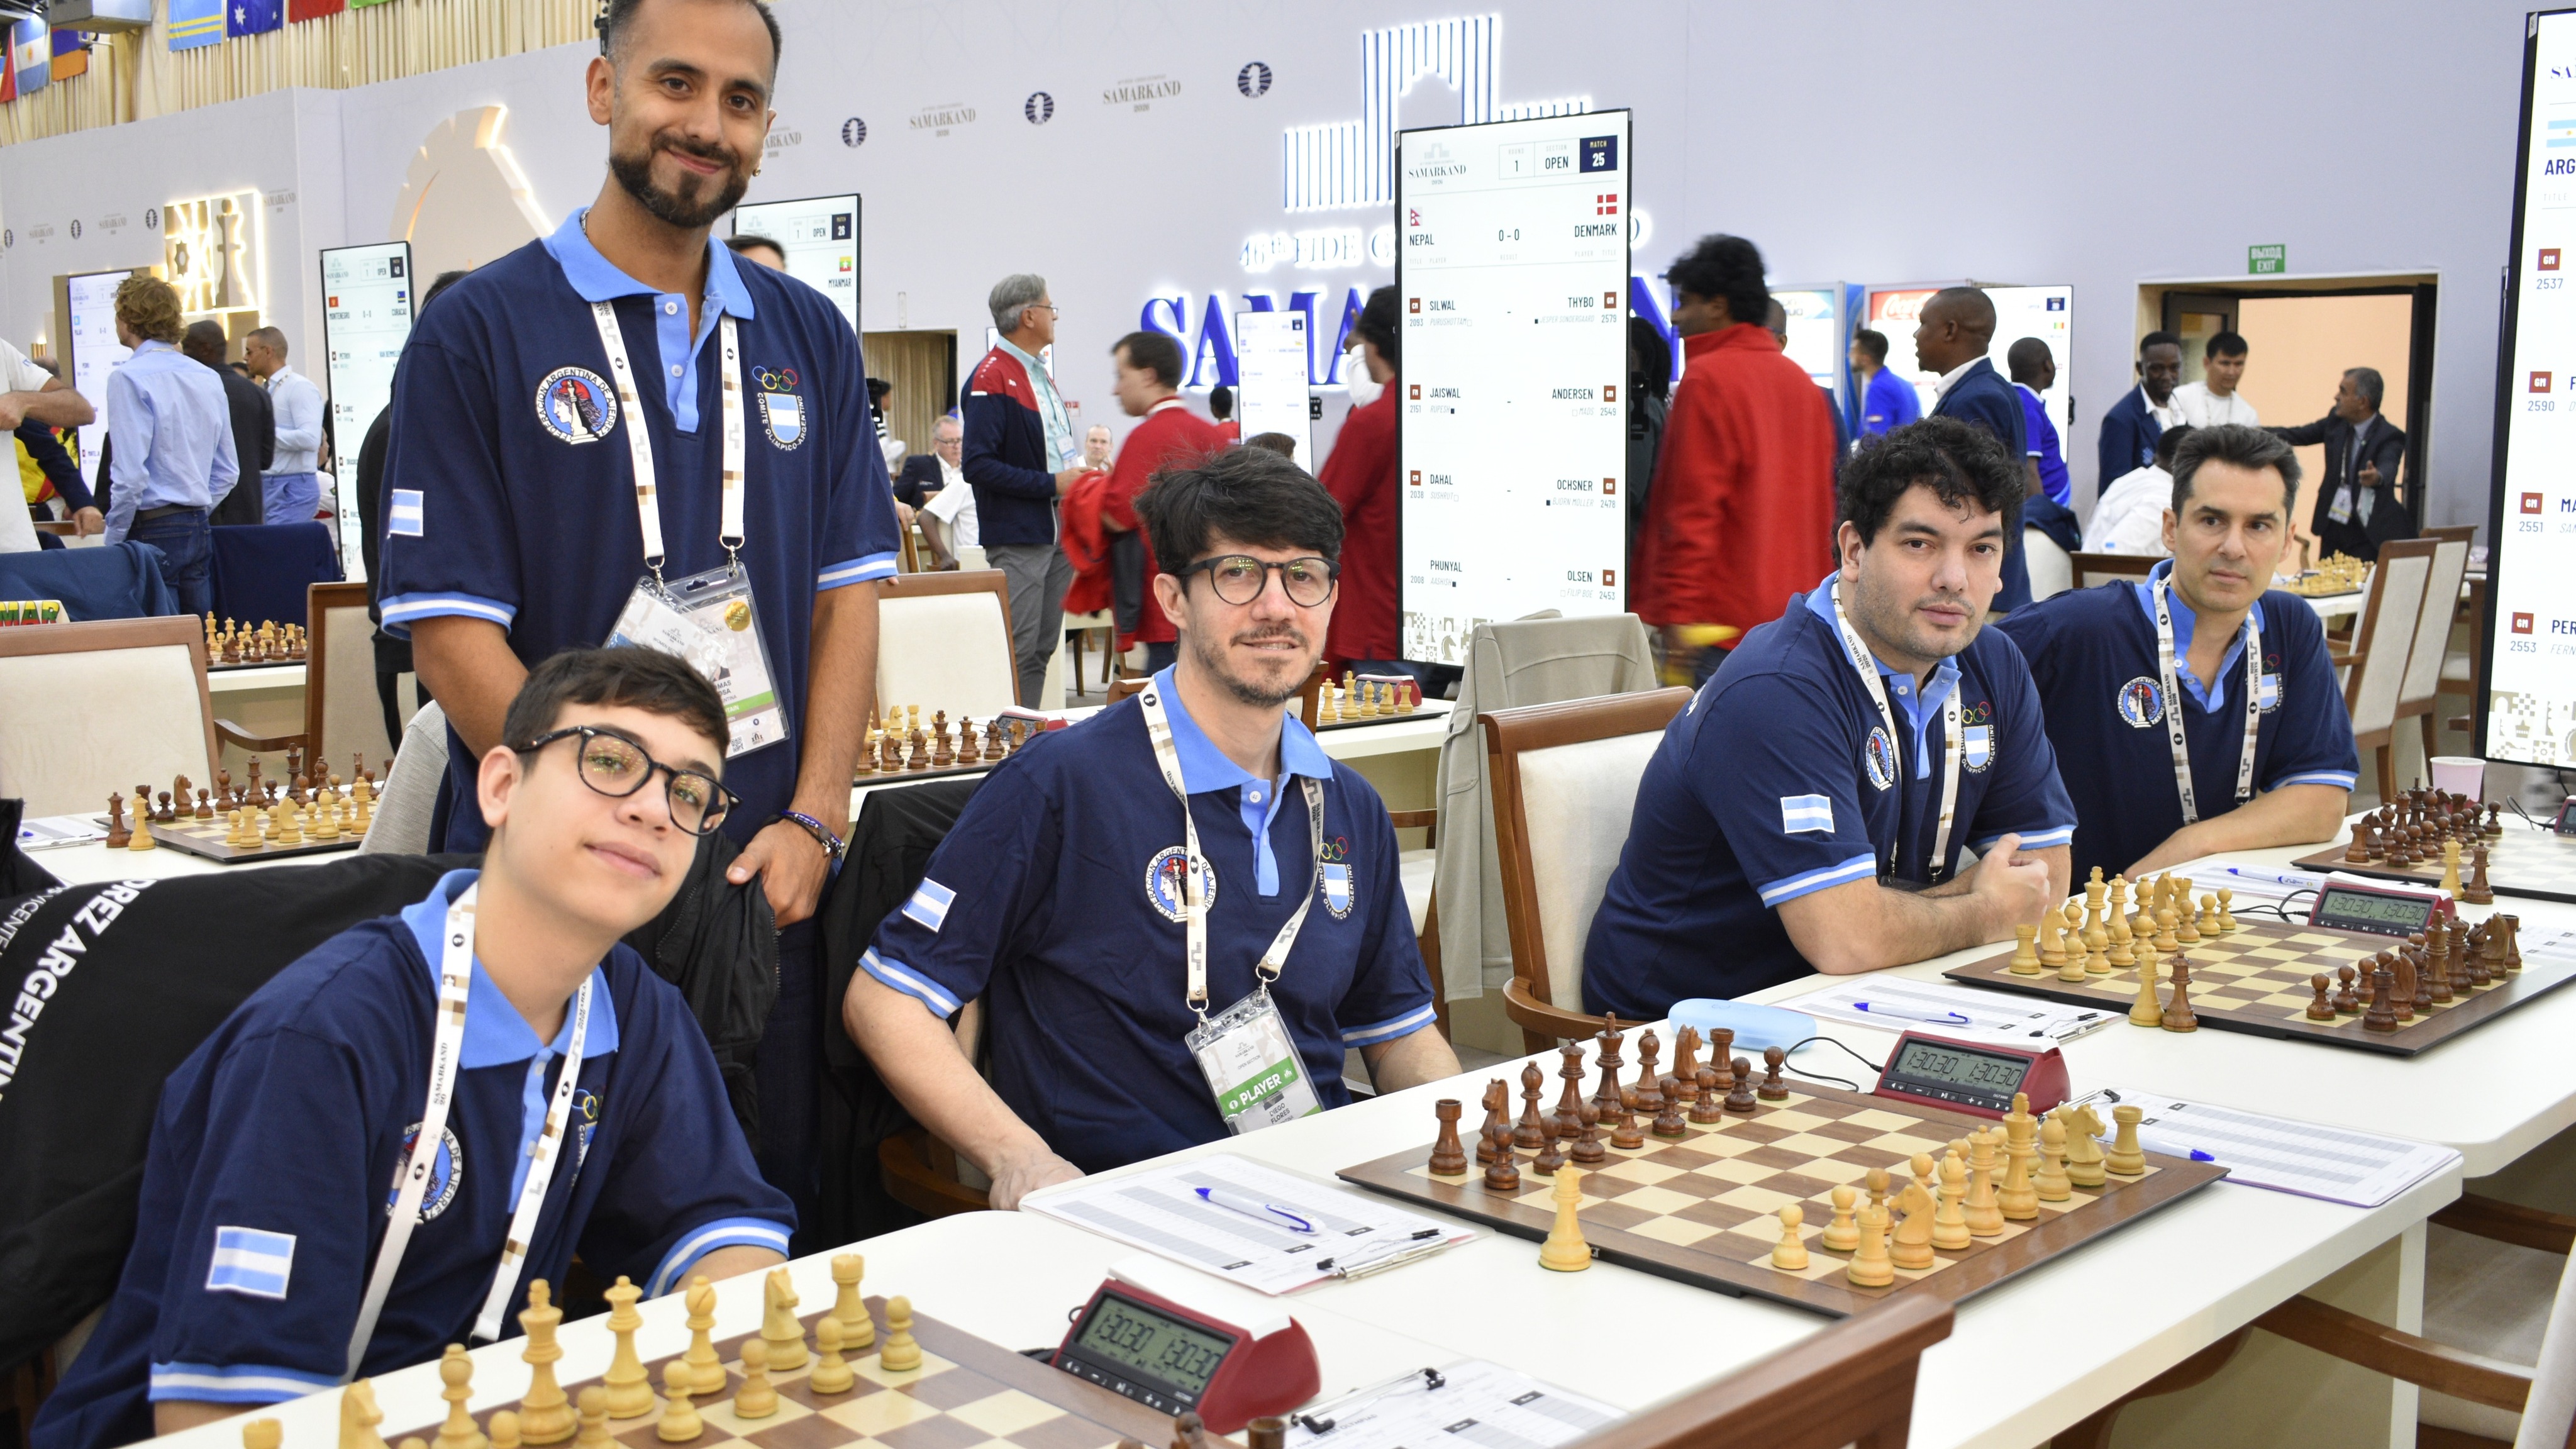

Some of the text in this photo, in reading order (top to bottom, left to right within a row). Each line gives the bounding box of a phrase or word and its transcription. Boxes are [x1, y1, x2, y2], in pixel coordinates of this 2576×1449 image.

[1103, 80, 1180, 104] SAMARKAND
[910, 108, 976, 130] SAMARKAND
[765, 132, 801, 148] ARKAND
[1590, 140, 1607, 148] MATCH
[1545, 156, 1568, 169] OPEN
[1592, 152, 1605, 167] 25
[1409, 165, 1466, 179] SAMARKAND
[1515, 160, 1518, 172] 1
[2544, 193, 2567, 201] TITLE
[813, 228, 826, 238] OPEN
[1574, 224, 1617, 238] DENMARK
[1409, 234, 1434, 246] NEPAL
[1293, 234, 1357, 265] FIDE
[2543, 255, 2555, 265] GM
[828, 278, 852, 289] MYANMAR
[2536, 278, 2563, 290] 2537
[1430, 300, 1456, 311] SILWAL
[1568, 297, 1594, 308] THYBO
[1409, 318, 1467, 326] 2093 PURUSHOTTAM
[1540, 316, 1558, 324] JESPER
[1601, 314, 1617, 323] 2579
[546, 369, 598, 387] ARGENTINA
[2534, 377, 2546, 387] GM
[598, 382, 611, 395] DE
[1430, 387, 1461, 399] JAISWAL
[1552, 389, 1594, 399] ANDERSEN
[1410, 405, 1450, 413] 2151 RUPESH
[1579, 407, 1616, 416] MADS 2549
[2528, 401, 2555, 411] 2590
[599, 397, 616, 435] AJEDREZ
[757, 392, 807, 451] COMITE OLIMPICO ARGENTINO
[1430, 474, 1453, 486] DAHAL
[1557, 479, 1593, 491] OCHSNER
[1410, 491, 1453, 500] 2038 SUSHRUT
[1552, 497, 1616, 509] BJORN MOLLER 2478
[2526, 499, 2538, 508] GM
[2519, 521, 2543, 533] 2551
[1430, 560, 1462, 572] PHUNYAL
[1411, 575, 1452, 586] 2008 AASHISH
[1568, 570, 1592, 582] OLSEN
[1567, 589, 1615, 600] FILIP BOE 2453
[2516, 618, 2529, 628] GM
[1846, 635, 1865, 670] SAMARKAND
[2511, 640, 2536, 653] 2553
[2165, 674, 2174, 706] SAMARKAND
[723, 694, 737, 702] NTINA
[726, 705, 740, 713] TAIN
[1962, 758, 1986, 774] OLIMPICO
[1987, 724, 1996, 766] ARGENTINO
[1146, 847, 1215, 918] FEDERACION ARGENT DE AJEDRE
[1323, 898, 1347, 920] OLIMPICO
[0, 923, 87, 1091] ARGENTI
[1238, 1055, 1261, 1070] OPEN SECTION
[433, 1042, 448, 1104] SAMARKAND
[1239, 1073, 1282, 1106] PLAYER
[1269, 1102, 1285, 1117] DIEGO
[1270, 1108, 1291, 1124] FLORES
[450, 1147, 462, 1163] DE
[429, 1167, 461, 1218] AJEDREZ
[1340, 1414, 1378, 1430] OLYMPIAD
